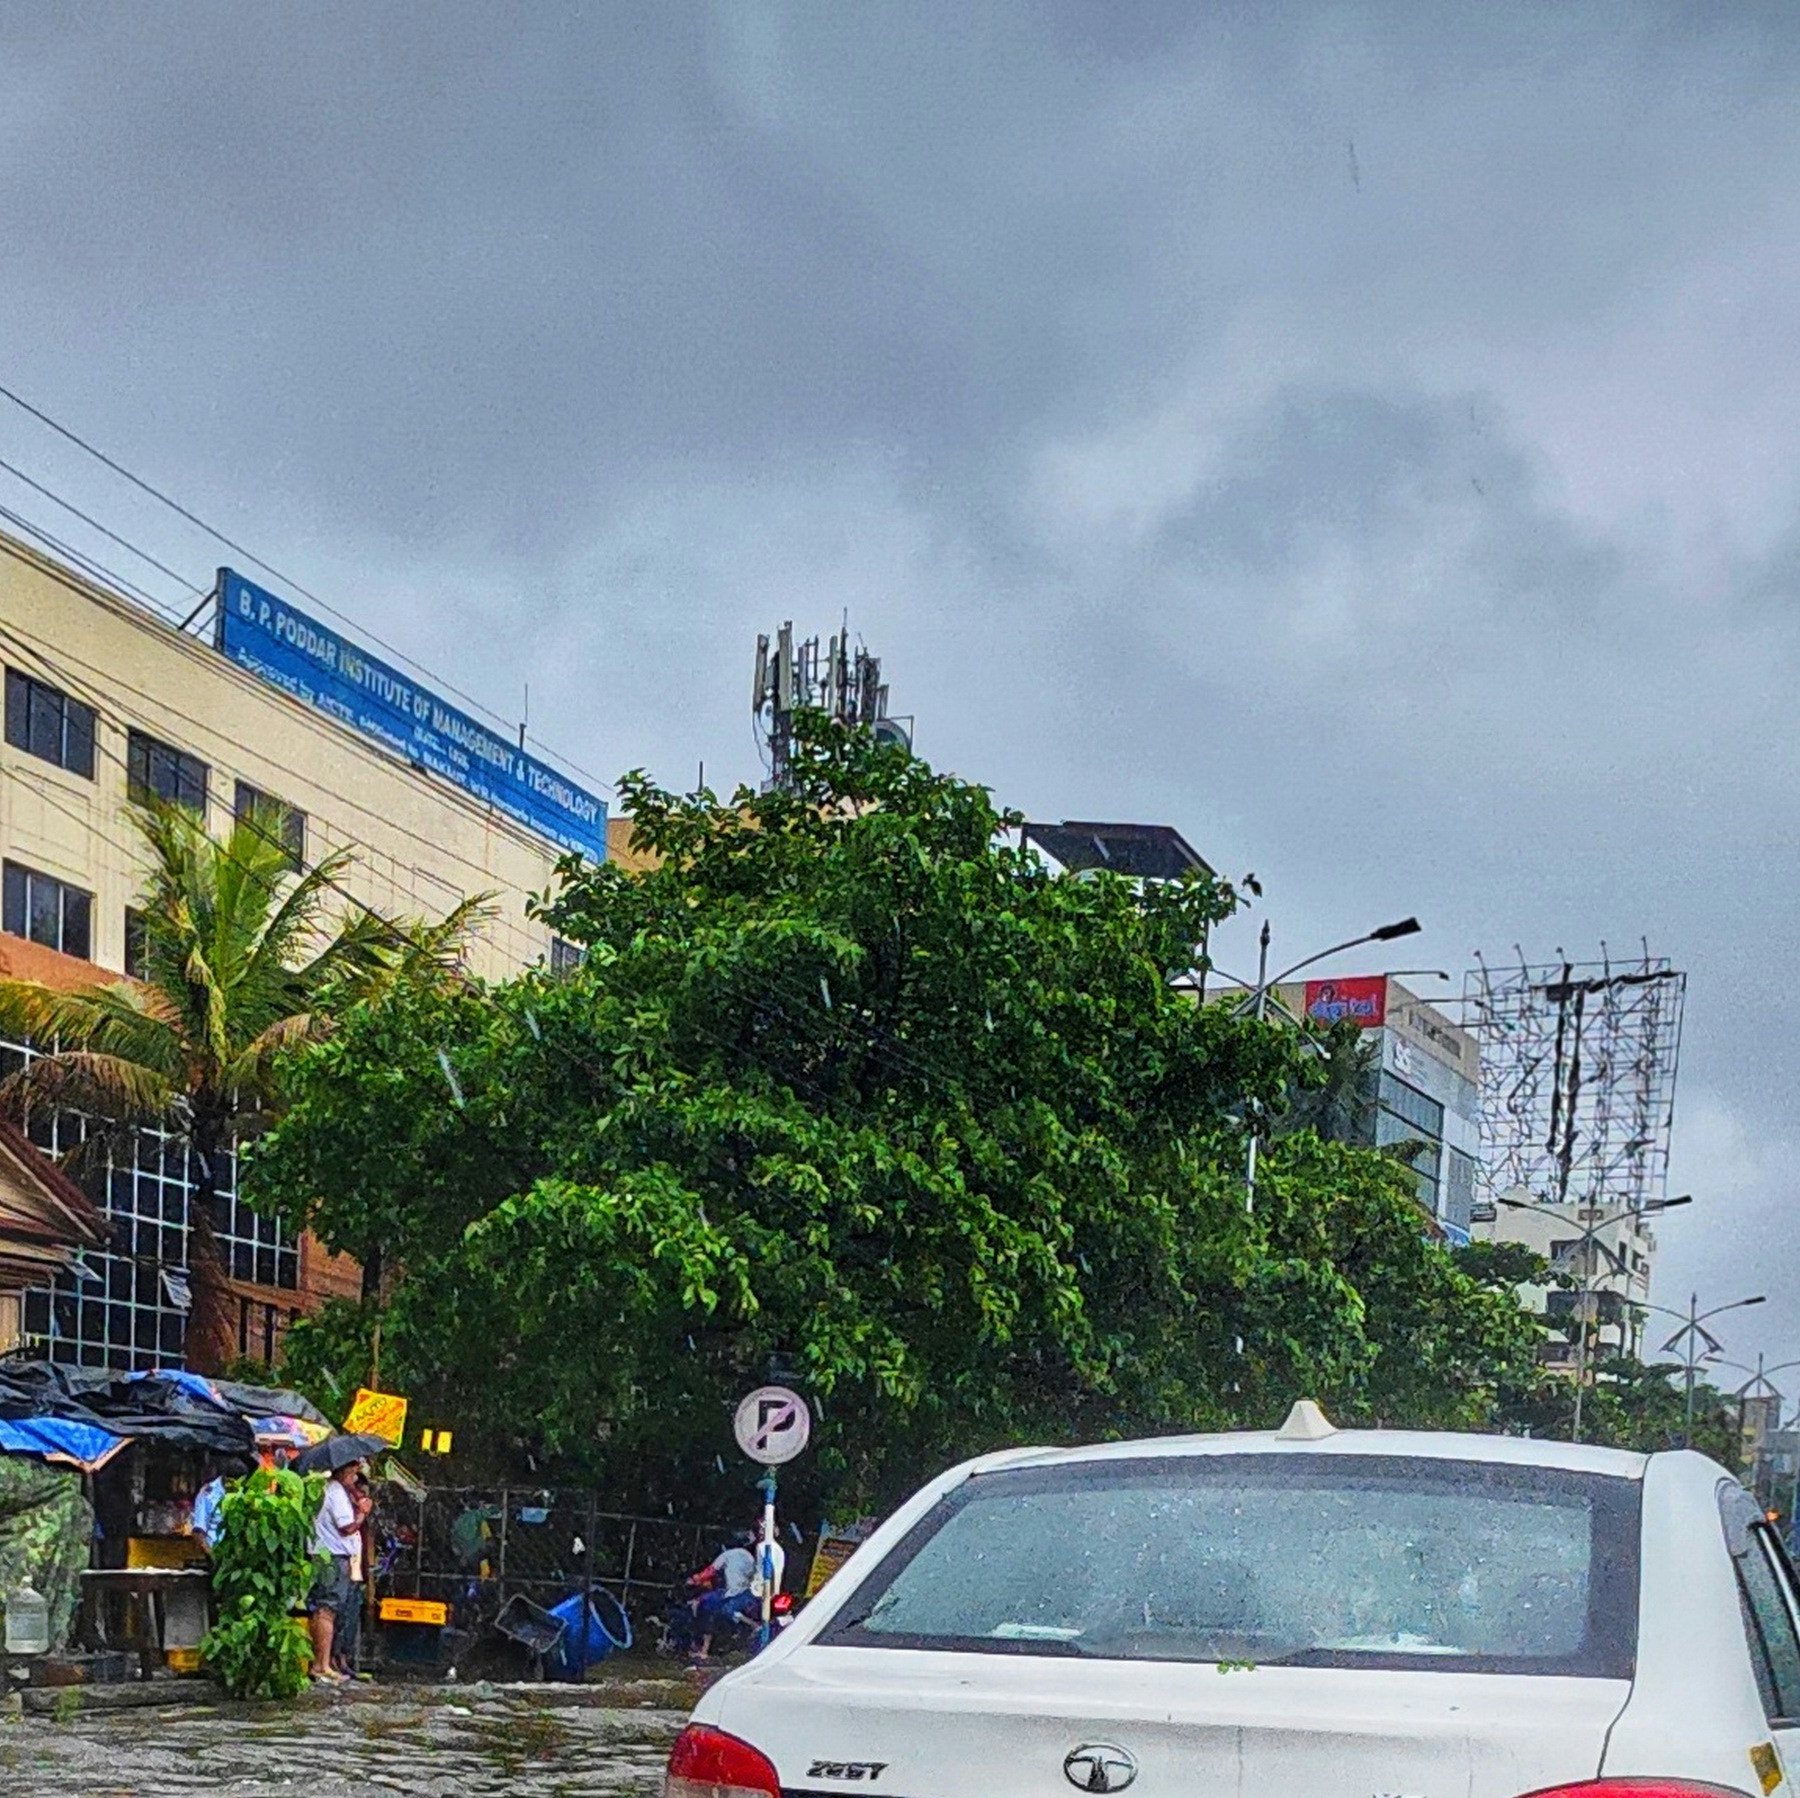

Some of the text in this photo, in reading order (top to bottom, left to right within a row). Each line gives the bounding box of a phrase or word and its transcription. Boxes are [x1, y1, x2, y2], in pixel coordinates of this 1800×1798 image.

[275, 611, 338, 671] PODDAR
[339, 648, 411, 712] INSTITUTE
[413, 695, 432, 722] OF
[432, 706, 516, 775] MANAGEMENT
[515, 758, 526, 782] &
[527, 764, 599, 825] TECHNOLOGY
[805, 1759, 890, 1781] ZEST
